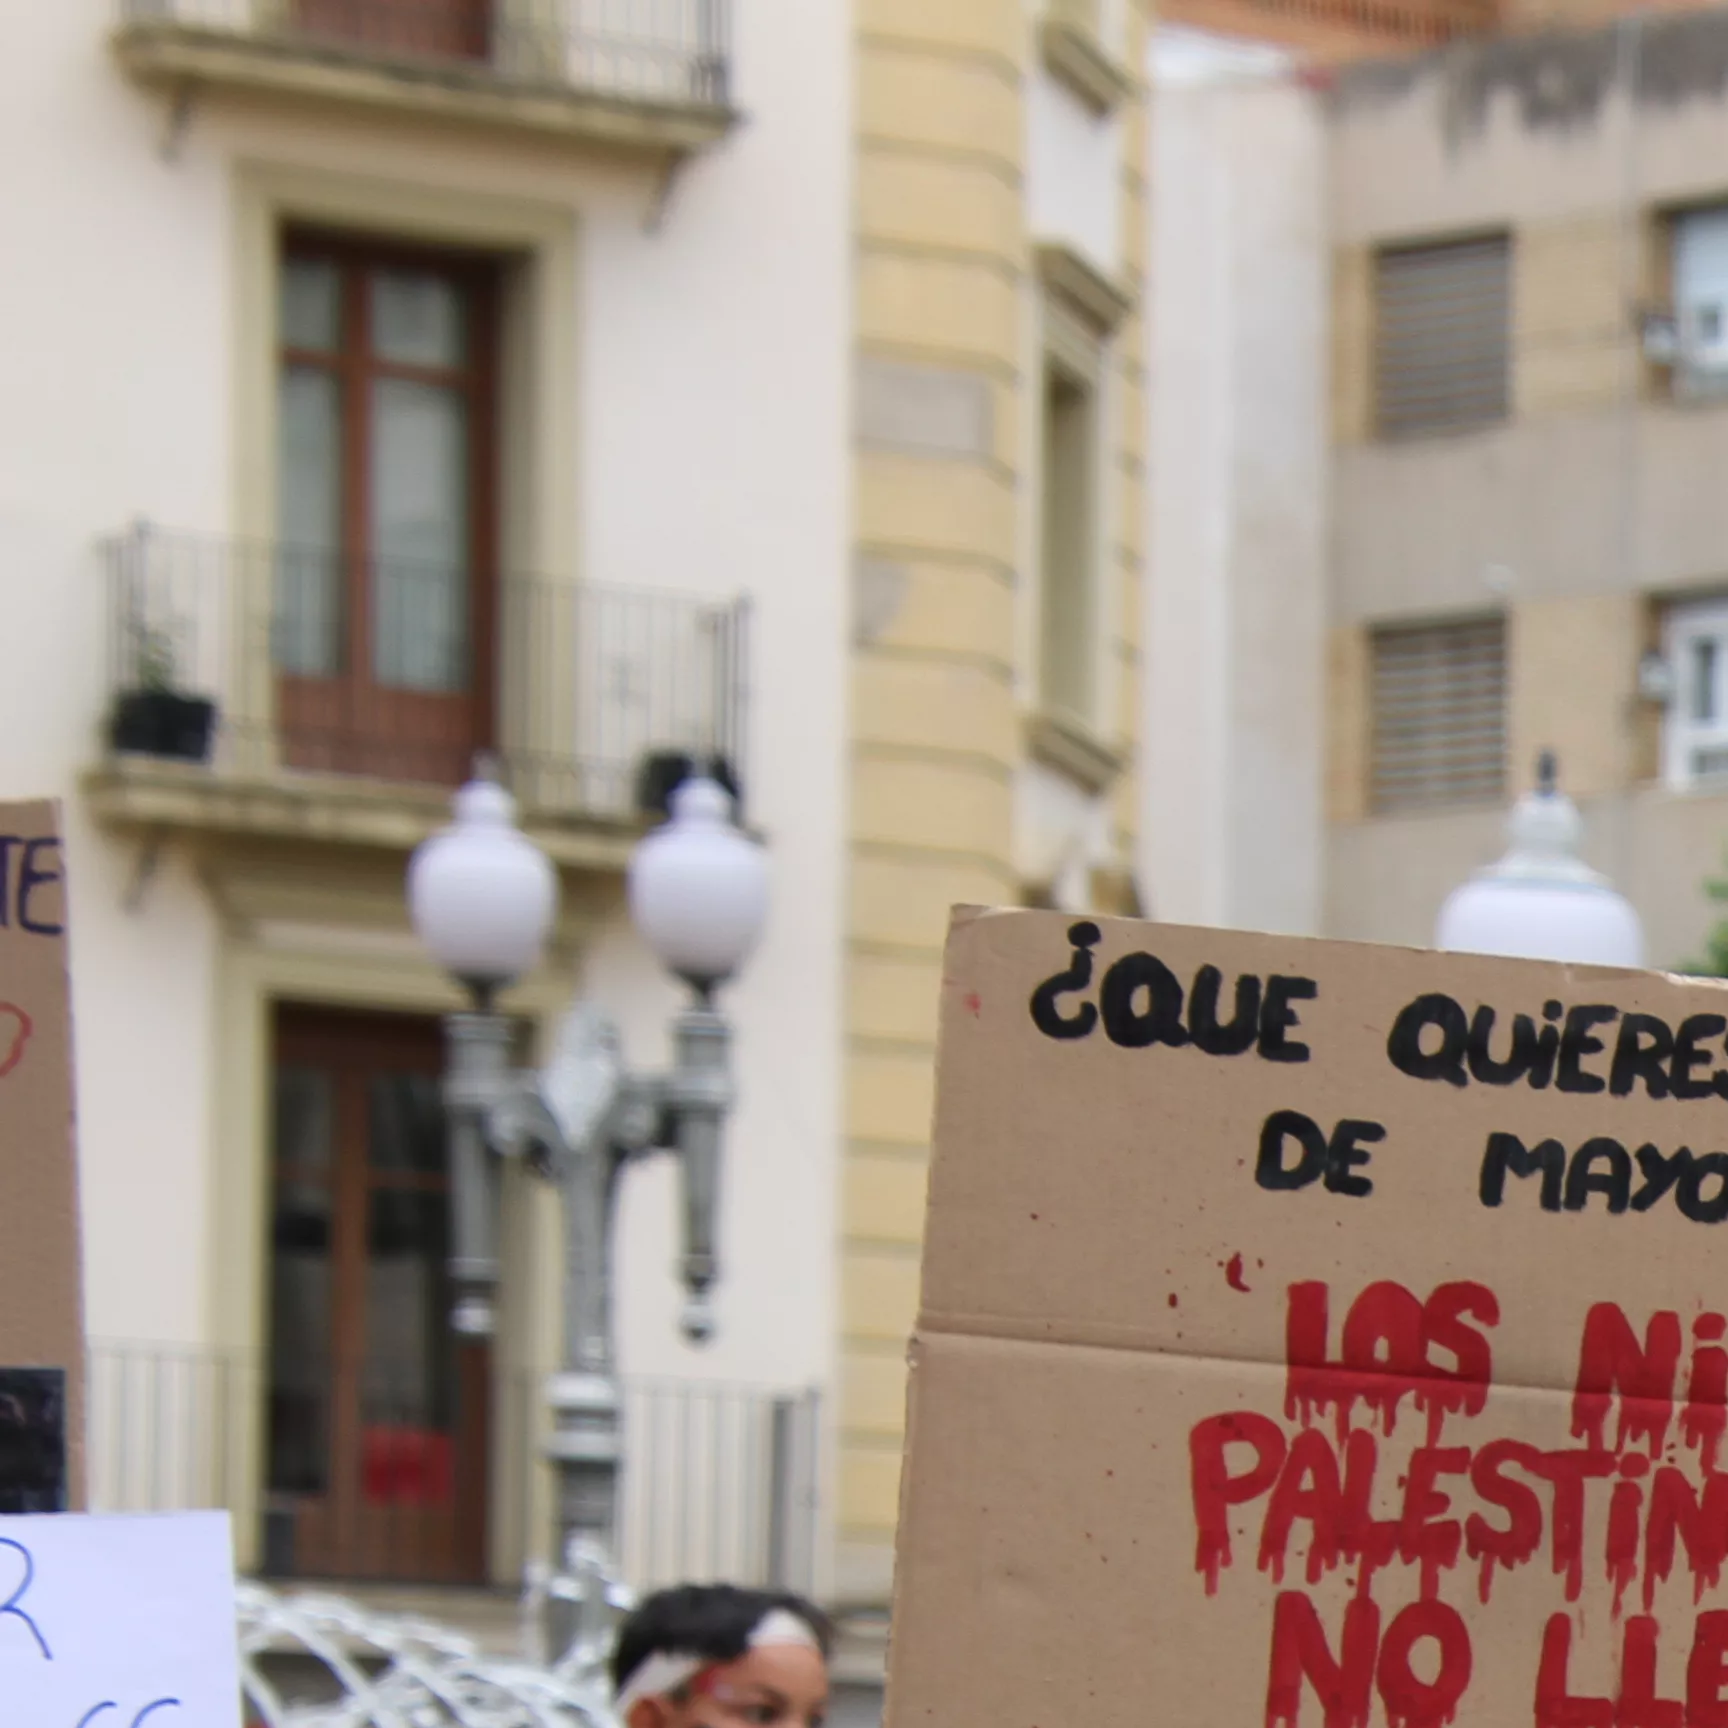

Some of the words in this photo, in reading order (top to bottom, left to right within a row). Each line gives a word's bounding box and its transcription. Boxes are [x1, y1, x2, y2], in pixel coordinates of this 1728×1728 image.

[1029, 921, 1318, 1064] ¿QUE
[1254, 1110, 1387, 1198] DE
[1283, 1279, 1500, 1432] LOS
